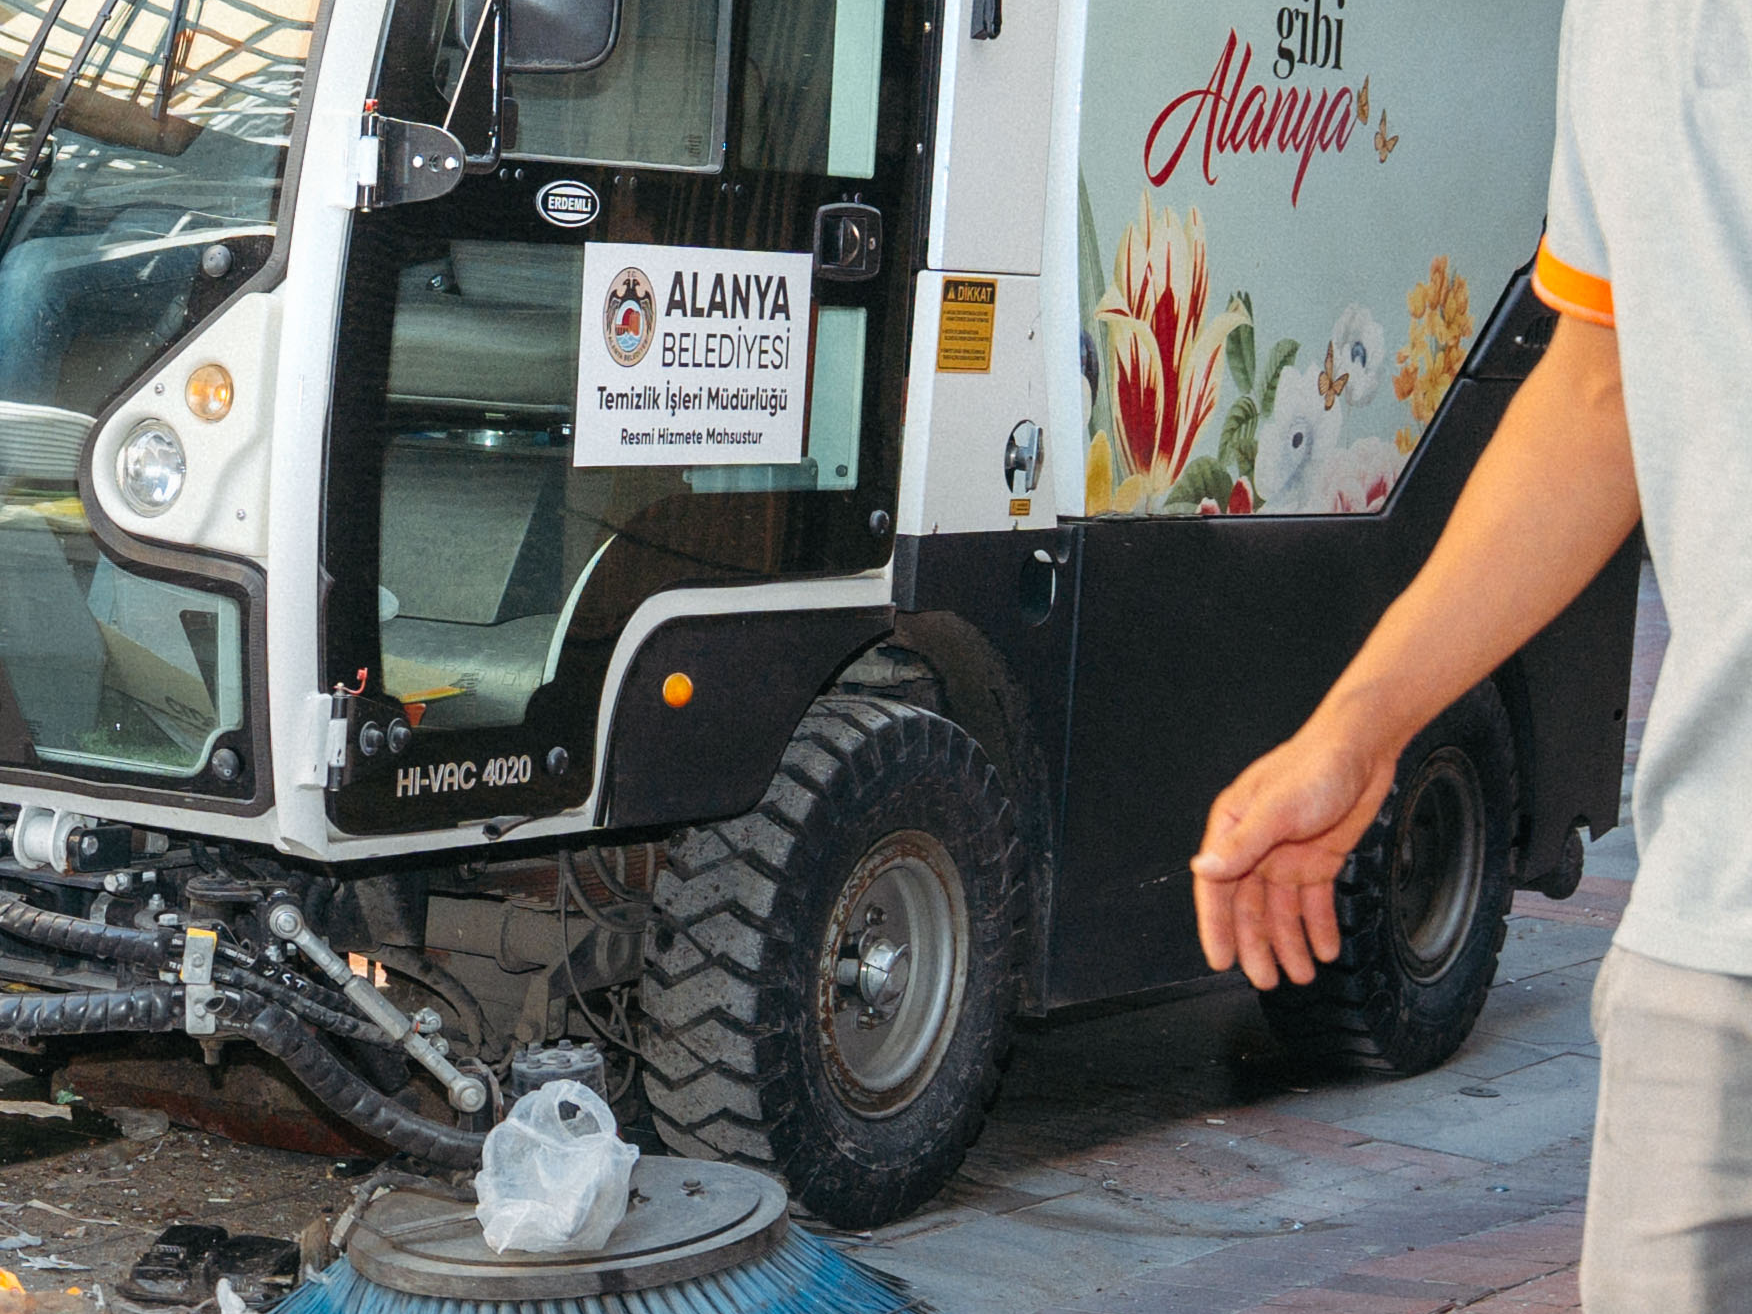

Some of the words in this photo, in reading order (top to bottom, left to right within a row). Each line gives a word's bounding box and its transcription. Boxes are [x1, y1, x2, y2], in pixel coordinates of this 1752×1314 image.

[1144, 27, 1358, 209] Alanya
[665, 271, 791, 321] ALANYA
[957, 283, 993, 302] DİKKAT
[661, 326, 791, 370] BELEDİYESİ
[597, 385, 661, 411] Temizlik
[664, 380, 703, 417] İşleri
[706, 386, 788, 417] Müdürlüğü
[620, 428, 655, 446] Resmi
[657, 429, 703, 446] Hizmete
[705, 429, 763, 445] Mahsustur
[396, 761, 477, 797] HI-VAC
[482, 754, 532, 787] 4020
